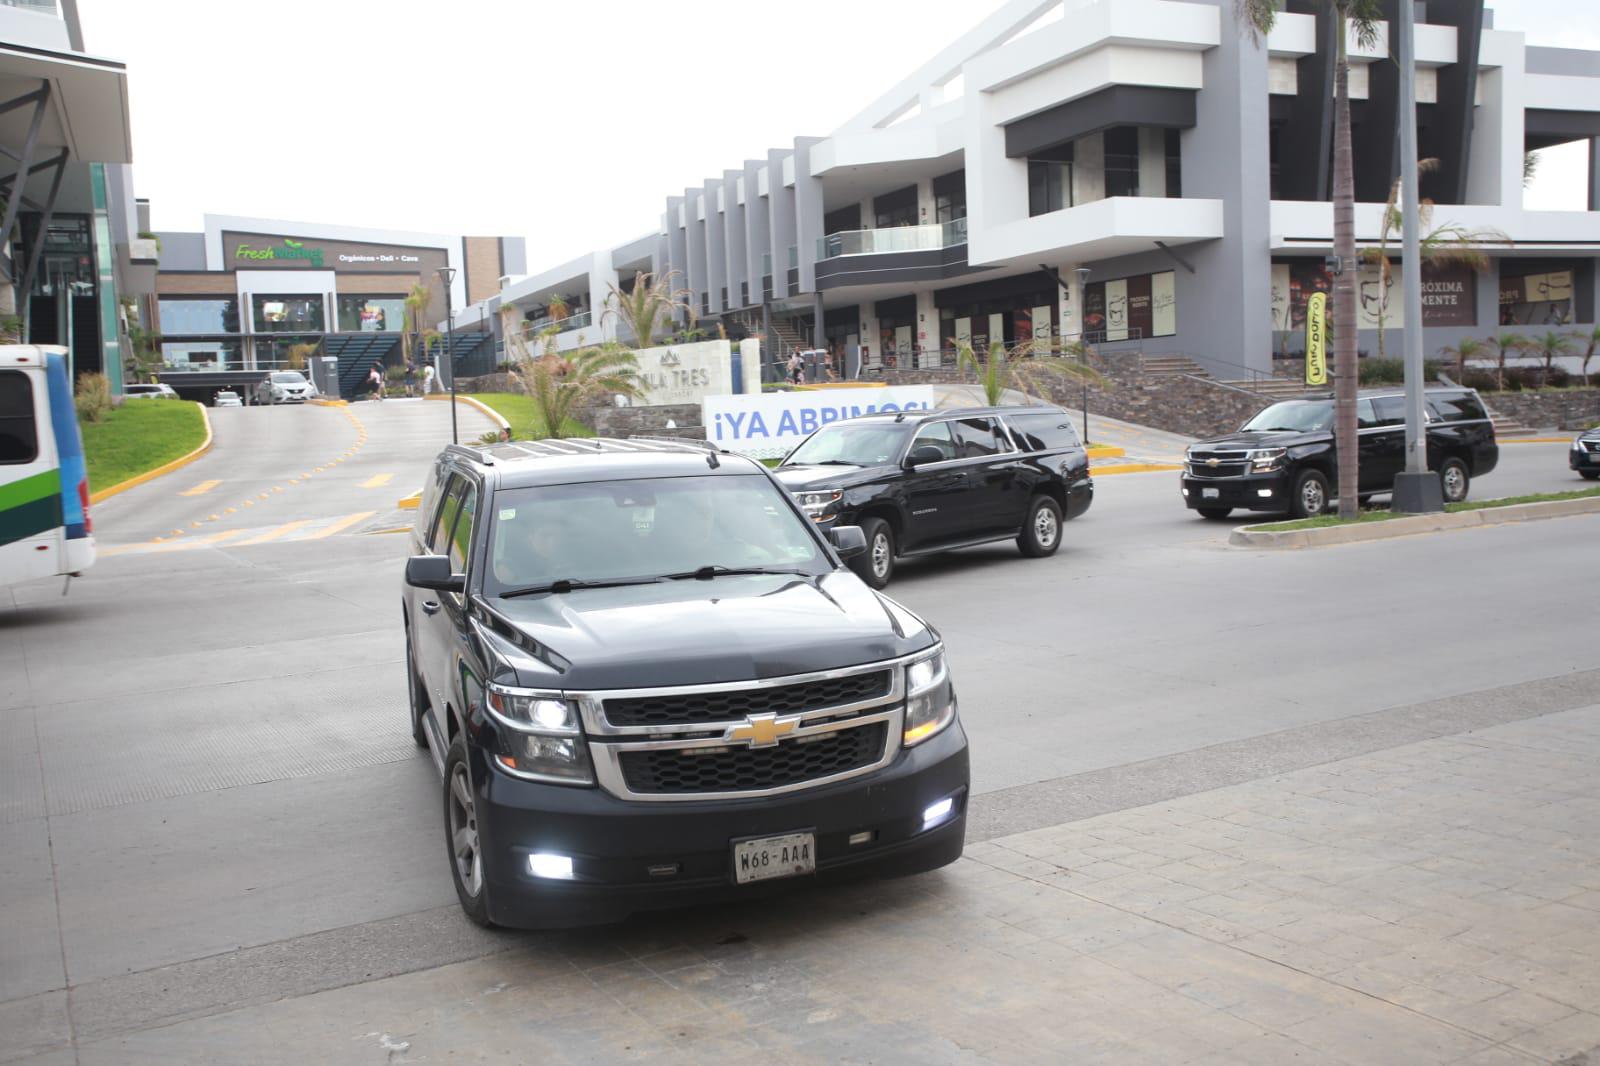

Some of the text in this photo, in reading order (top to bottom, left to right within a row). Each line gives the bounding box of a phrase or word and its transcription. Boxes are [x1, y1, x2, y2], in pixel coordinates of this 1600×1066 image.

[235, 244, 274, 260] Fresh
[1419, 279, 1464, 292] RÓXIMA
[672, 367, 710, 388] TRES
